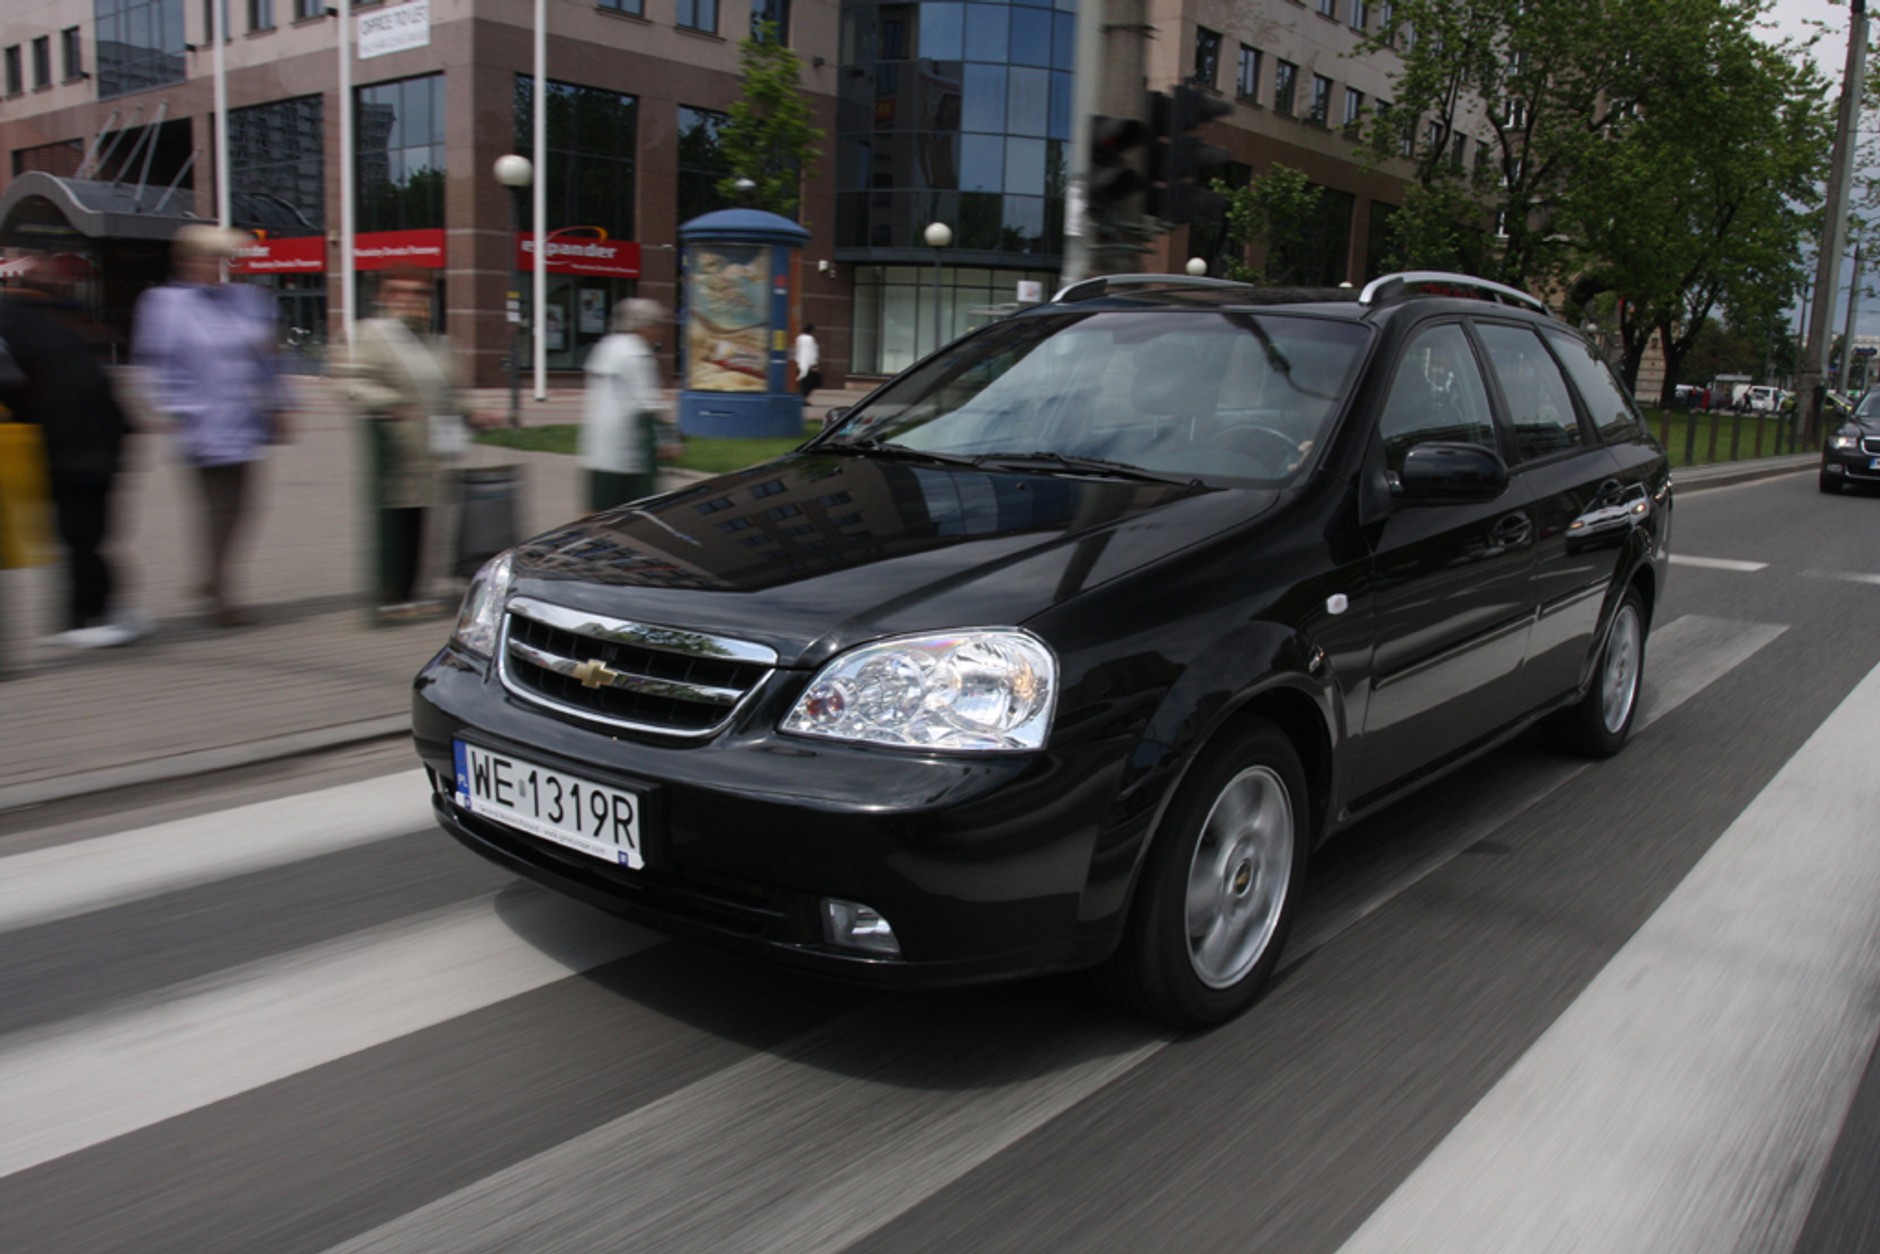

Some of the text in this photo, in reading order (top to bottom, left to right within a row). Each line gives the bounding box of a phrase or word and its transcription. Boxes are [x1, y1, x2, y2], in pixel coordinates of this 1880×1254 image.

[521, 240, 617, 259] epander
[457, 773, 469, 788] PL
[471, 750, 635, 849] WE 1319R
